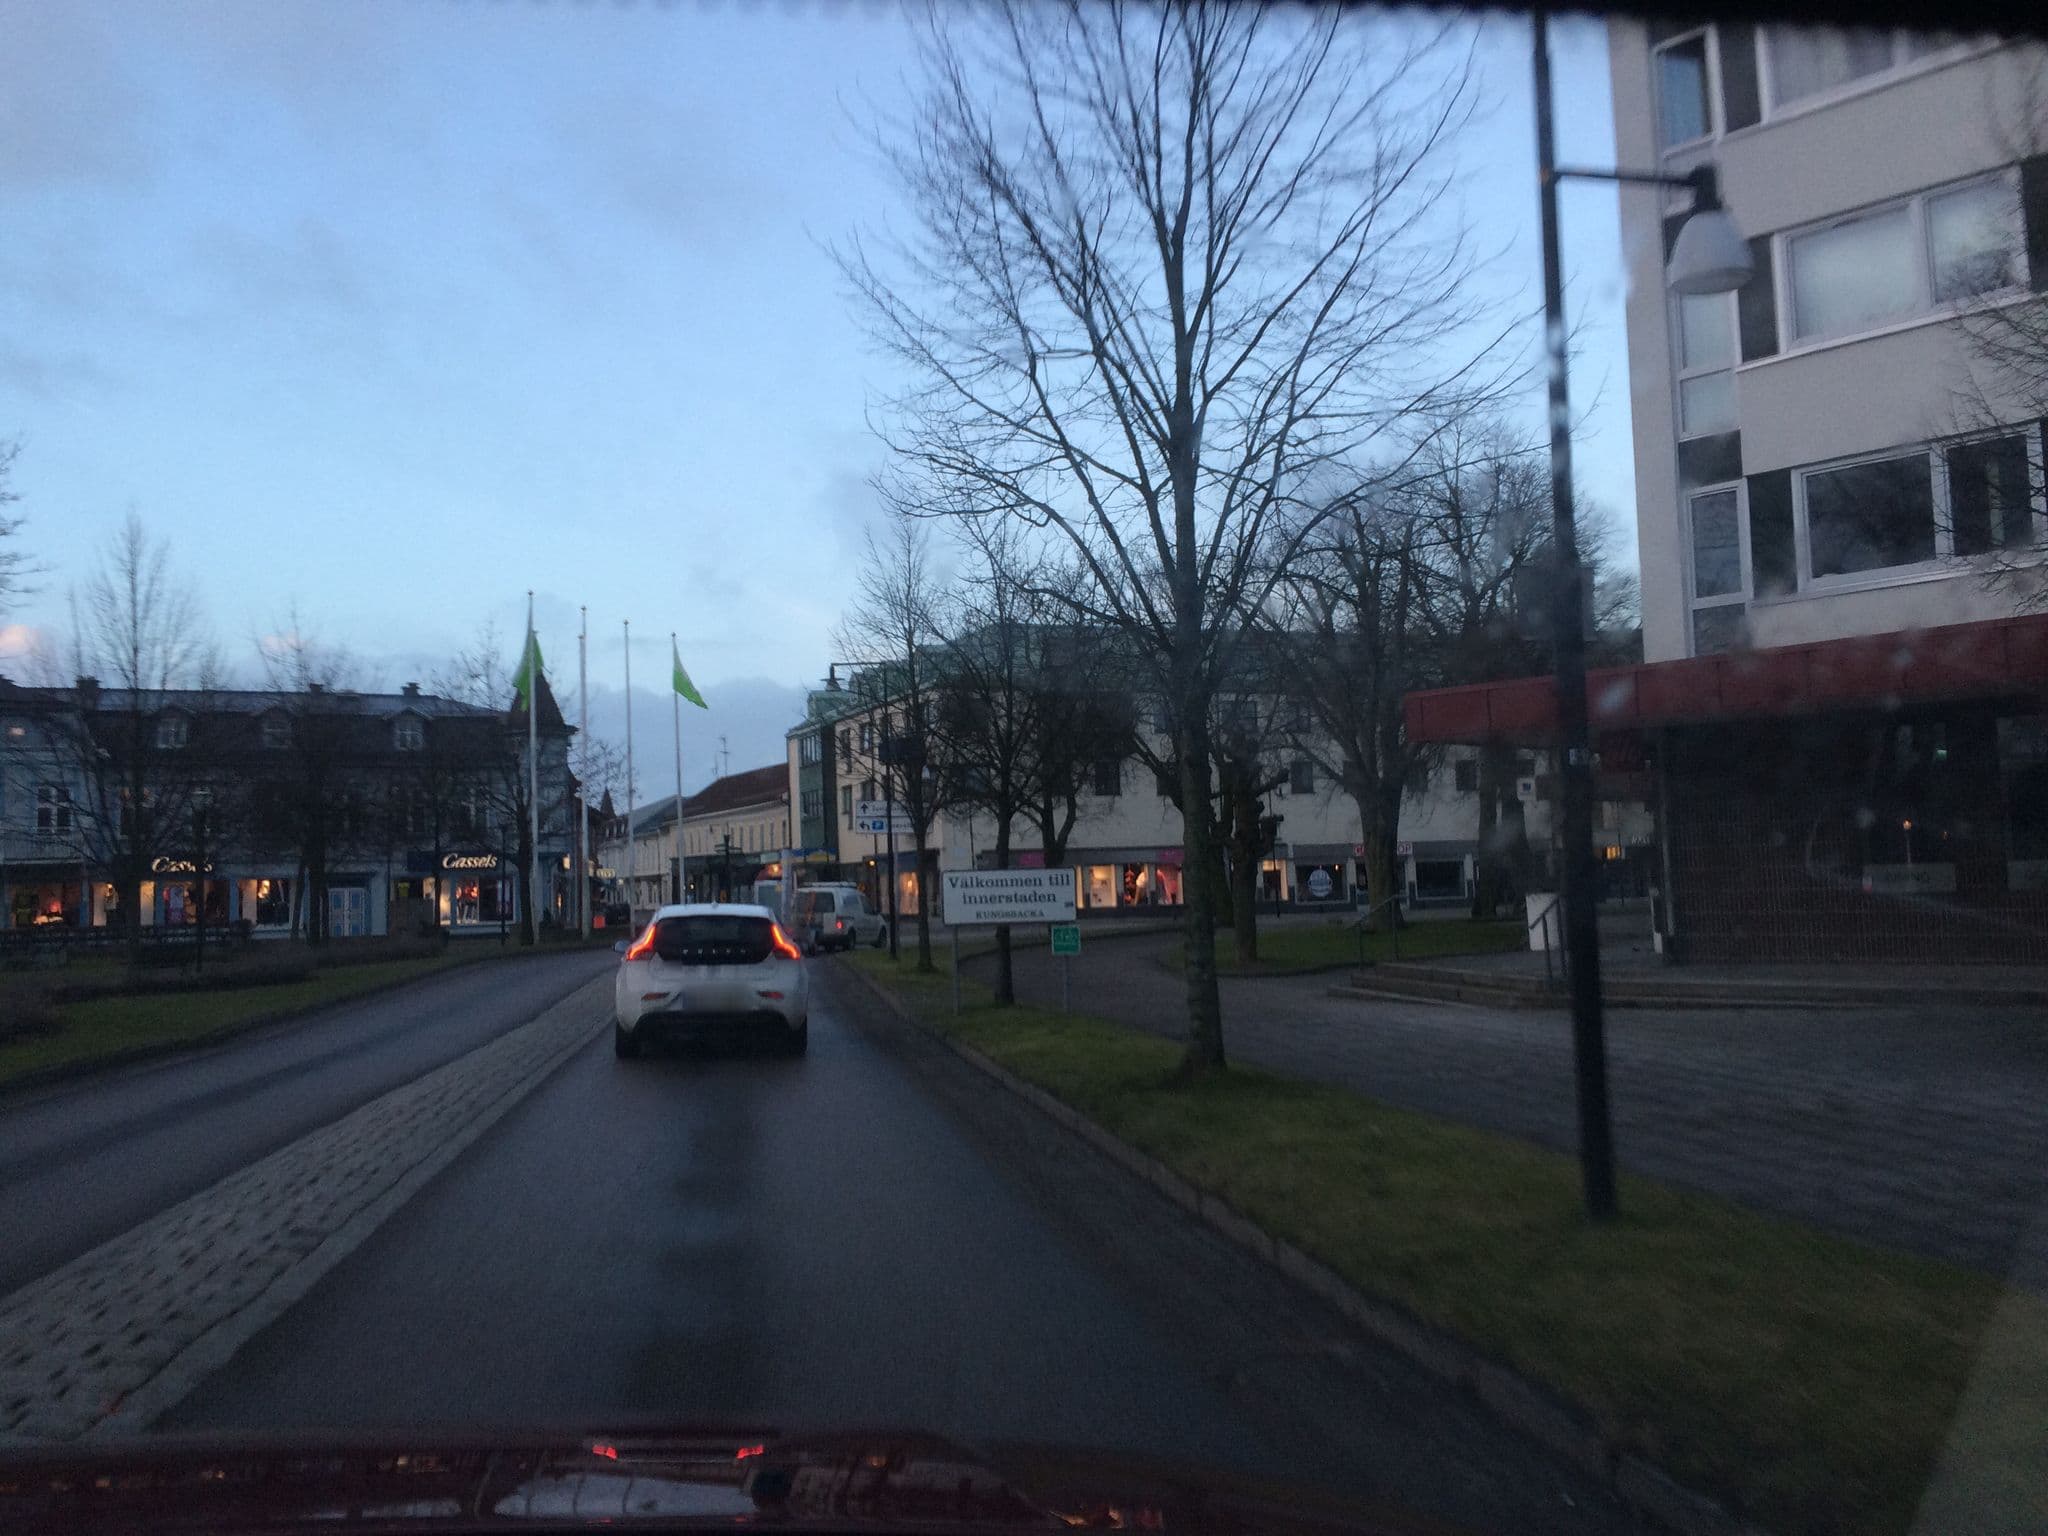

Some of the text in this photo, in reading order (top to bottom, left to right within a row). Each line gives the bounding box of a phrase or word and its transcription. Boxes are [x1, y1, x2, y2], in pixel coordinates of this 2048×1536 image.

[442, 852, 498, 869] Cassels
[949, 873, 1070, 889] Välkommen till
[962, 890, 1057, 905] innerstaden
[976, 910, 1045, 920] KUNGSBACKA
